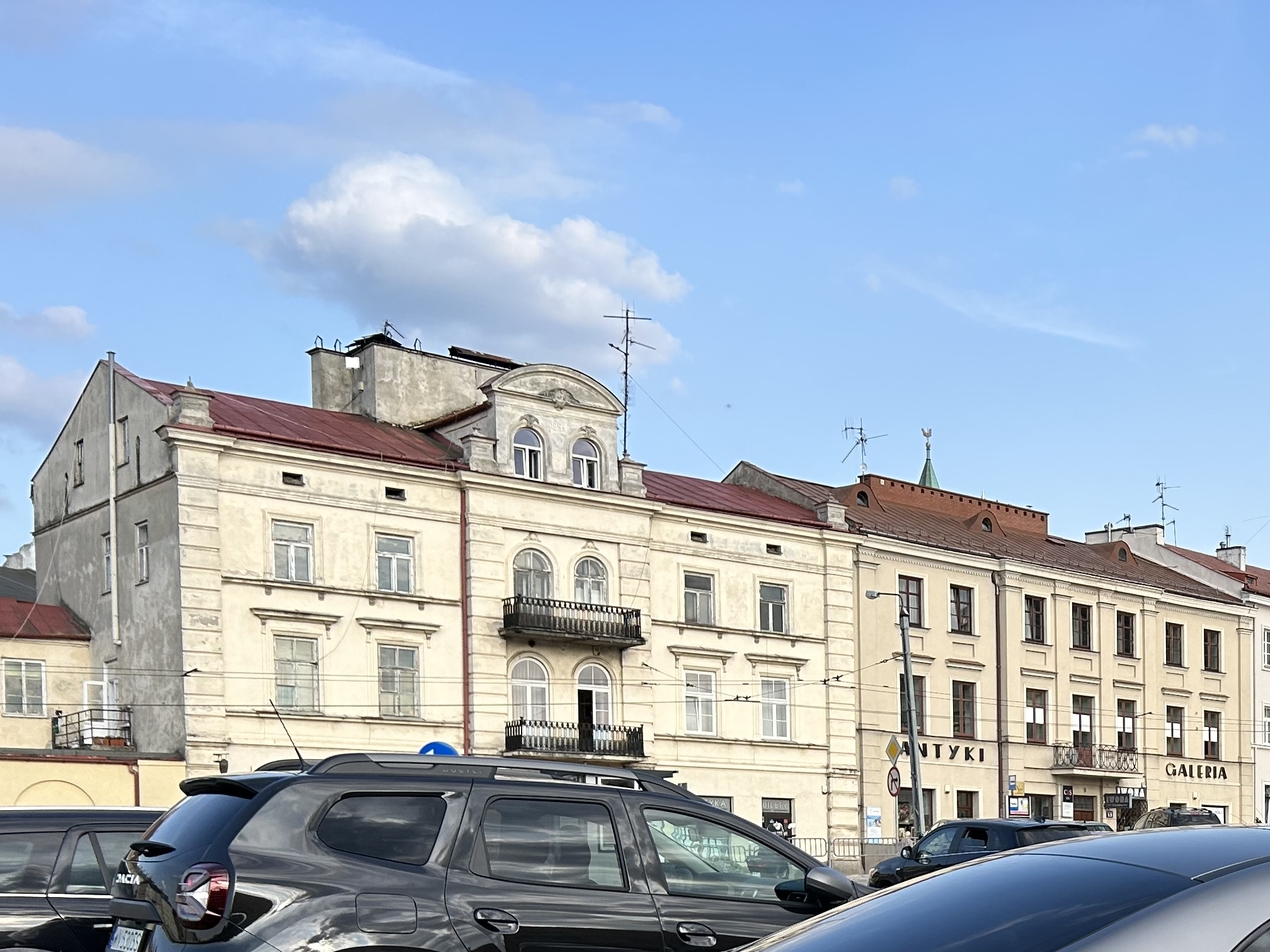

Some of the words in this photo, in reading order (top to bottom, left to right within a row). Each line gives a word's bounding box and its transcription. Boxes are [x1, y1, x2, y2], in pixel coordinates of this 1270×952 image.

[901, 741, 984, 762] ANTYKI
[1165, 762, 1228, 780] GALERIA
[763, 800, 788, 808] BILETY
